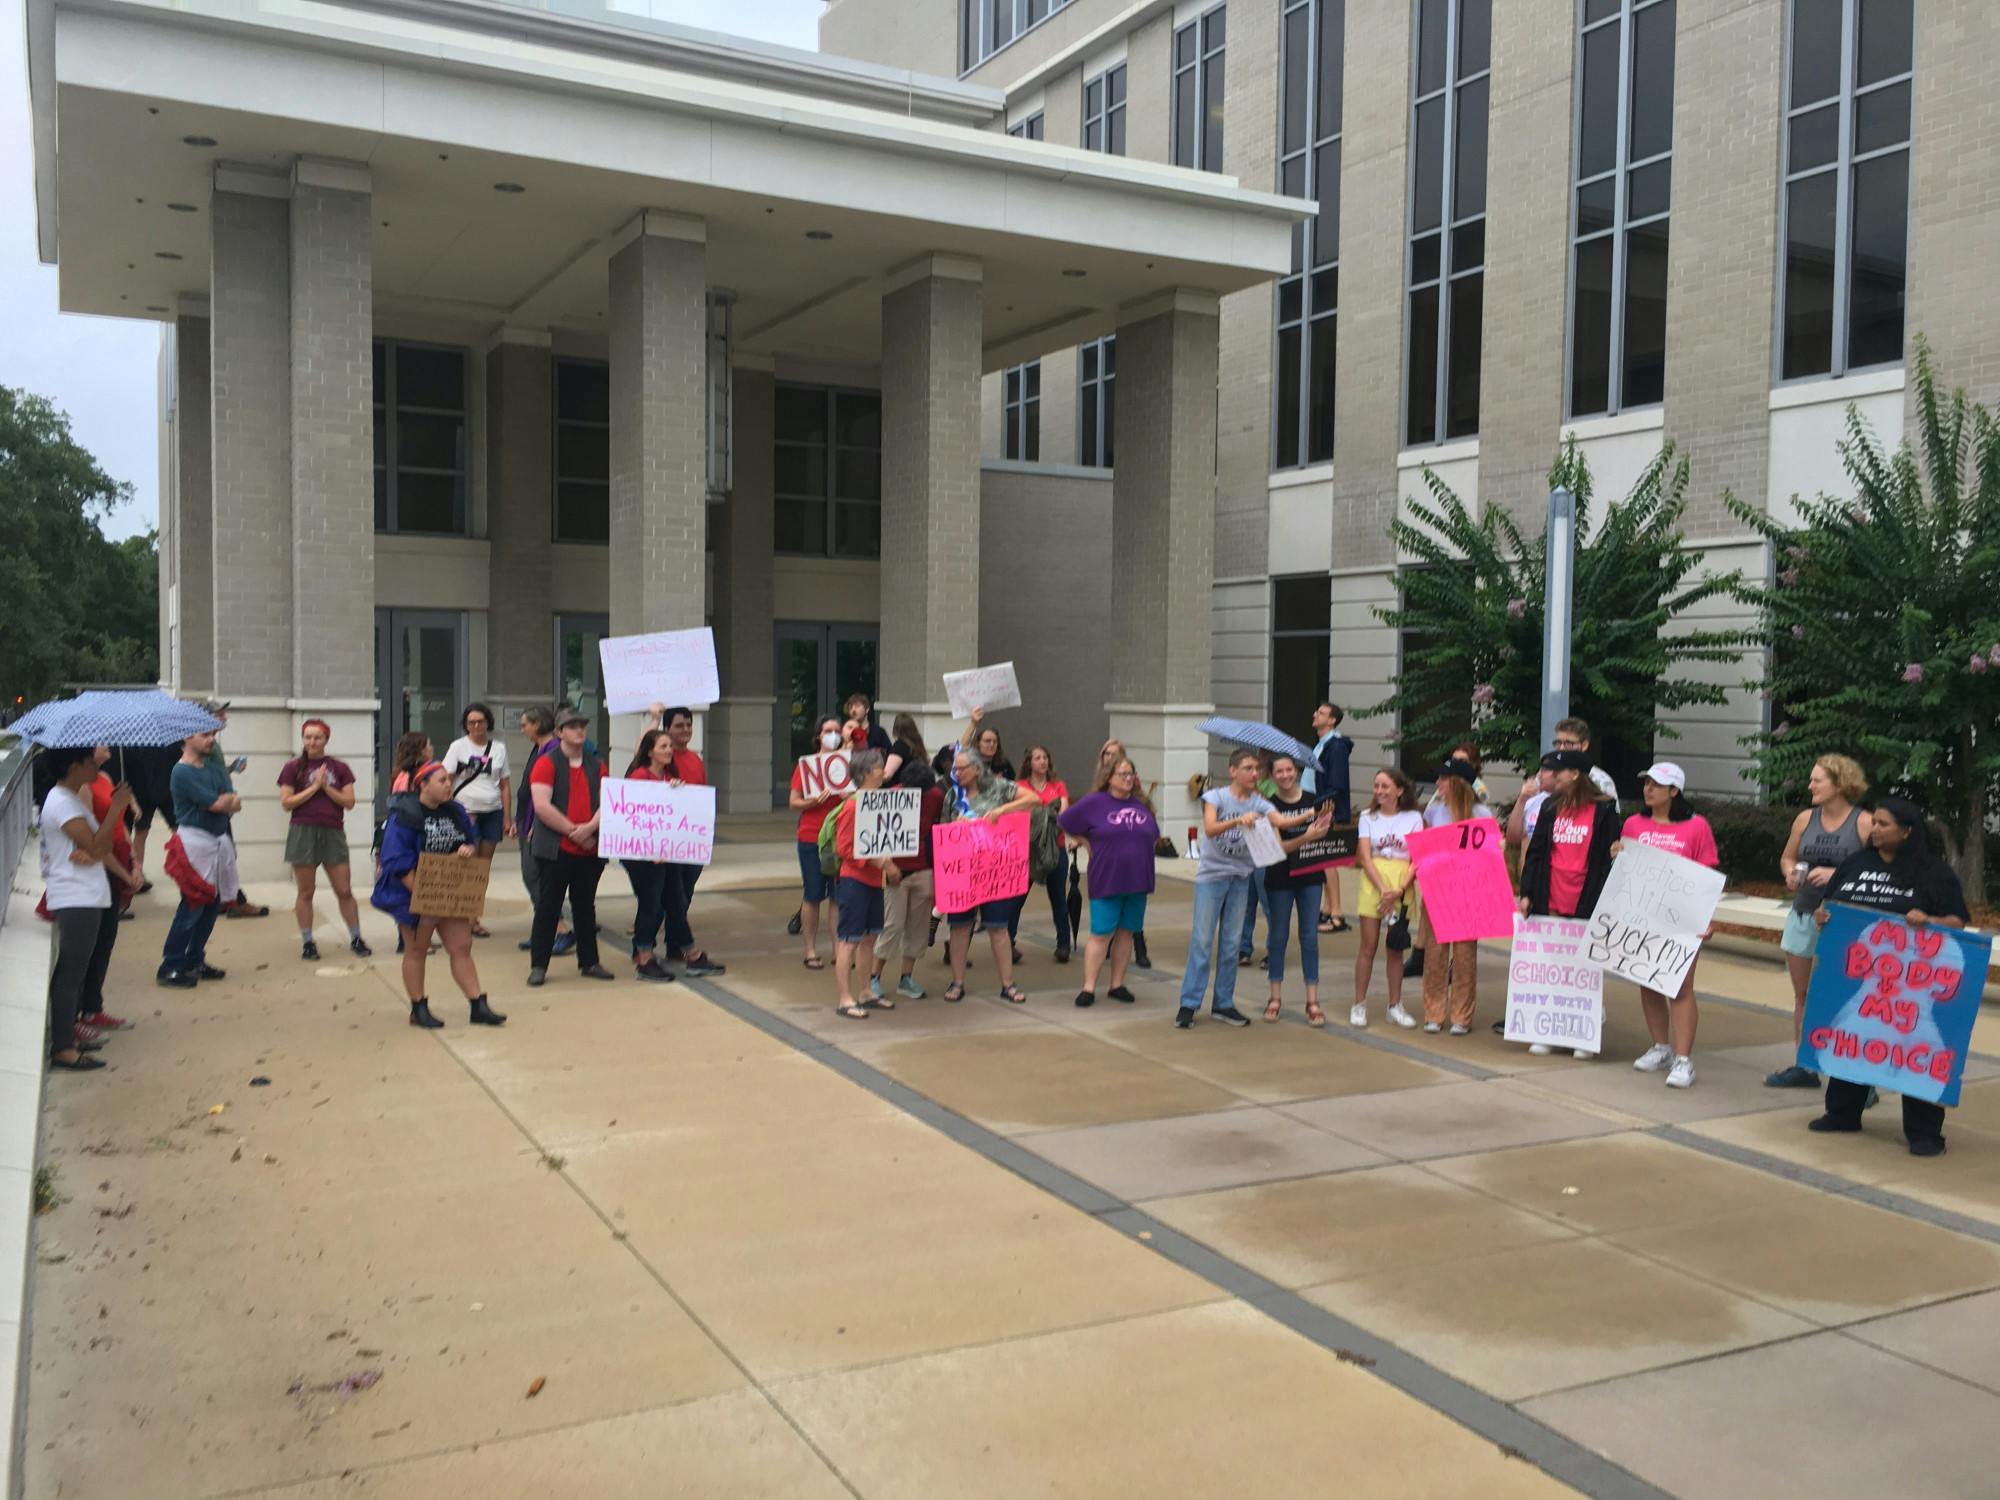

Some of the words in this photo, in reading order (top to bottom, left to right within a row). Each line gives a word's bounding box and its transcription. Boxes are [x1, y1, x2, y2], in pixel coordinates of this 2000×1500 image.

[802, 754, 850, 797] NO
[607, 784, 673, 815] Womens
[860, 791, 919, 812] ABORTION:
[628, 813, 672, 837] Rights
[678, 816, 707, 836] Are
[877, 812, 903, 834] NO
[1553, 815, 1573, 827] ANS
[1564, 825, 1589, 836] OUR
[603, 832, 654, 857] HUMAN
[660, 839, 710, 862] RIGHTS
[860, 830, 917, 856] SHAME
[1300, 840, 1335, 851] Abortion
[1552, 832, 1584, 844] ODIES
[1300, 848, 1326, 859] Health
[1619, 854, 1697, 897] Justice
[1855, 883, 1867, 892] A
[1859, 871, 1892, 882] RACI
[947, 889, 977, 908] THIS
[1590, 913, 1661, 962] SUCK
[1869, 919, 1944, 959] MY
[1511, 960, 1600, 991] CHOICE
[1588, 942, 1668, 989] DICK
[1845, 941, 1963, 1001] BODY
[1512, 992, 1549, 1006] WHY
[1553, 994, 1593, 1011] WITH
[1509, 1008, 1526, 1034] A
[1534, 1011, 1597, 1042] CHILD
[1858, 994, 1920, 1035] MY
[1808, 1026, 1956, 1084] CHOICE
